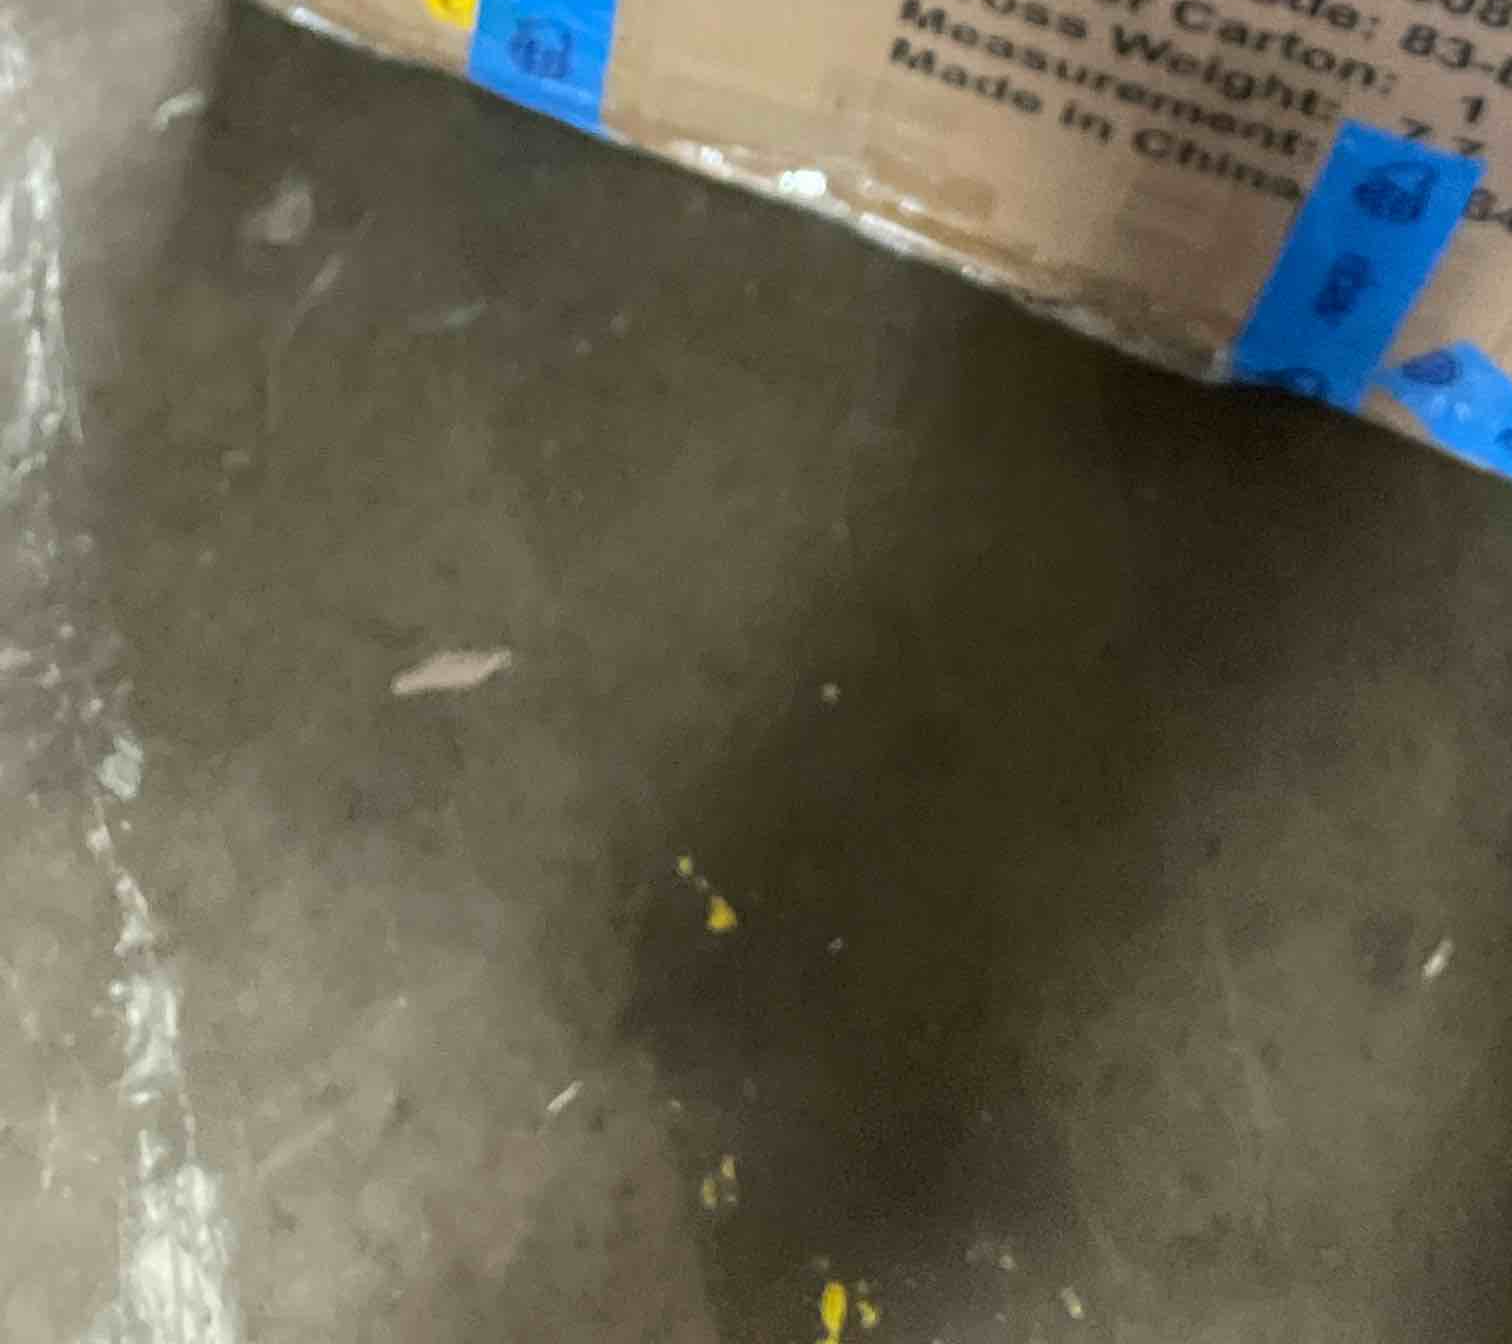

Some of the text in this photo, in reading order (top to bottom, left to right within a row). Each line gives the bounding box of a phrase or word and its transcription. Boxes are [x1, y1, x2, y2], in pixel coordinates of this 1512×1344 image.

[889, 37, 1305, 201] Made in China
[1110, 23, 1343, 122] Weight:
[1462, 95, 1485, 124] 1
